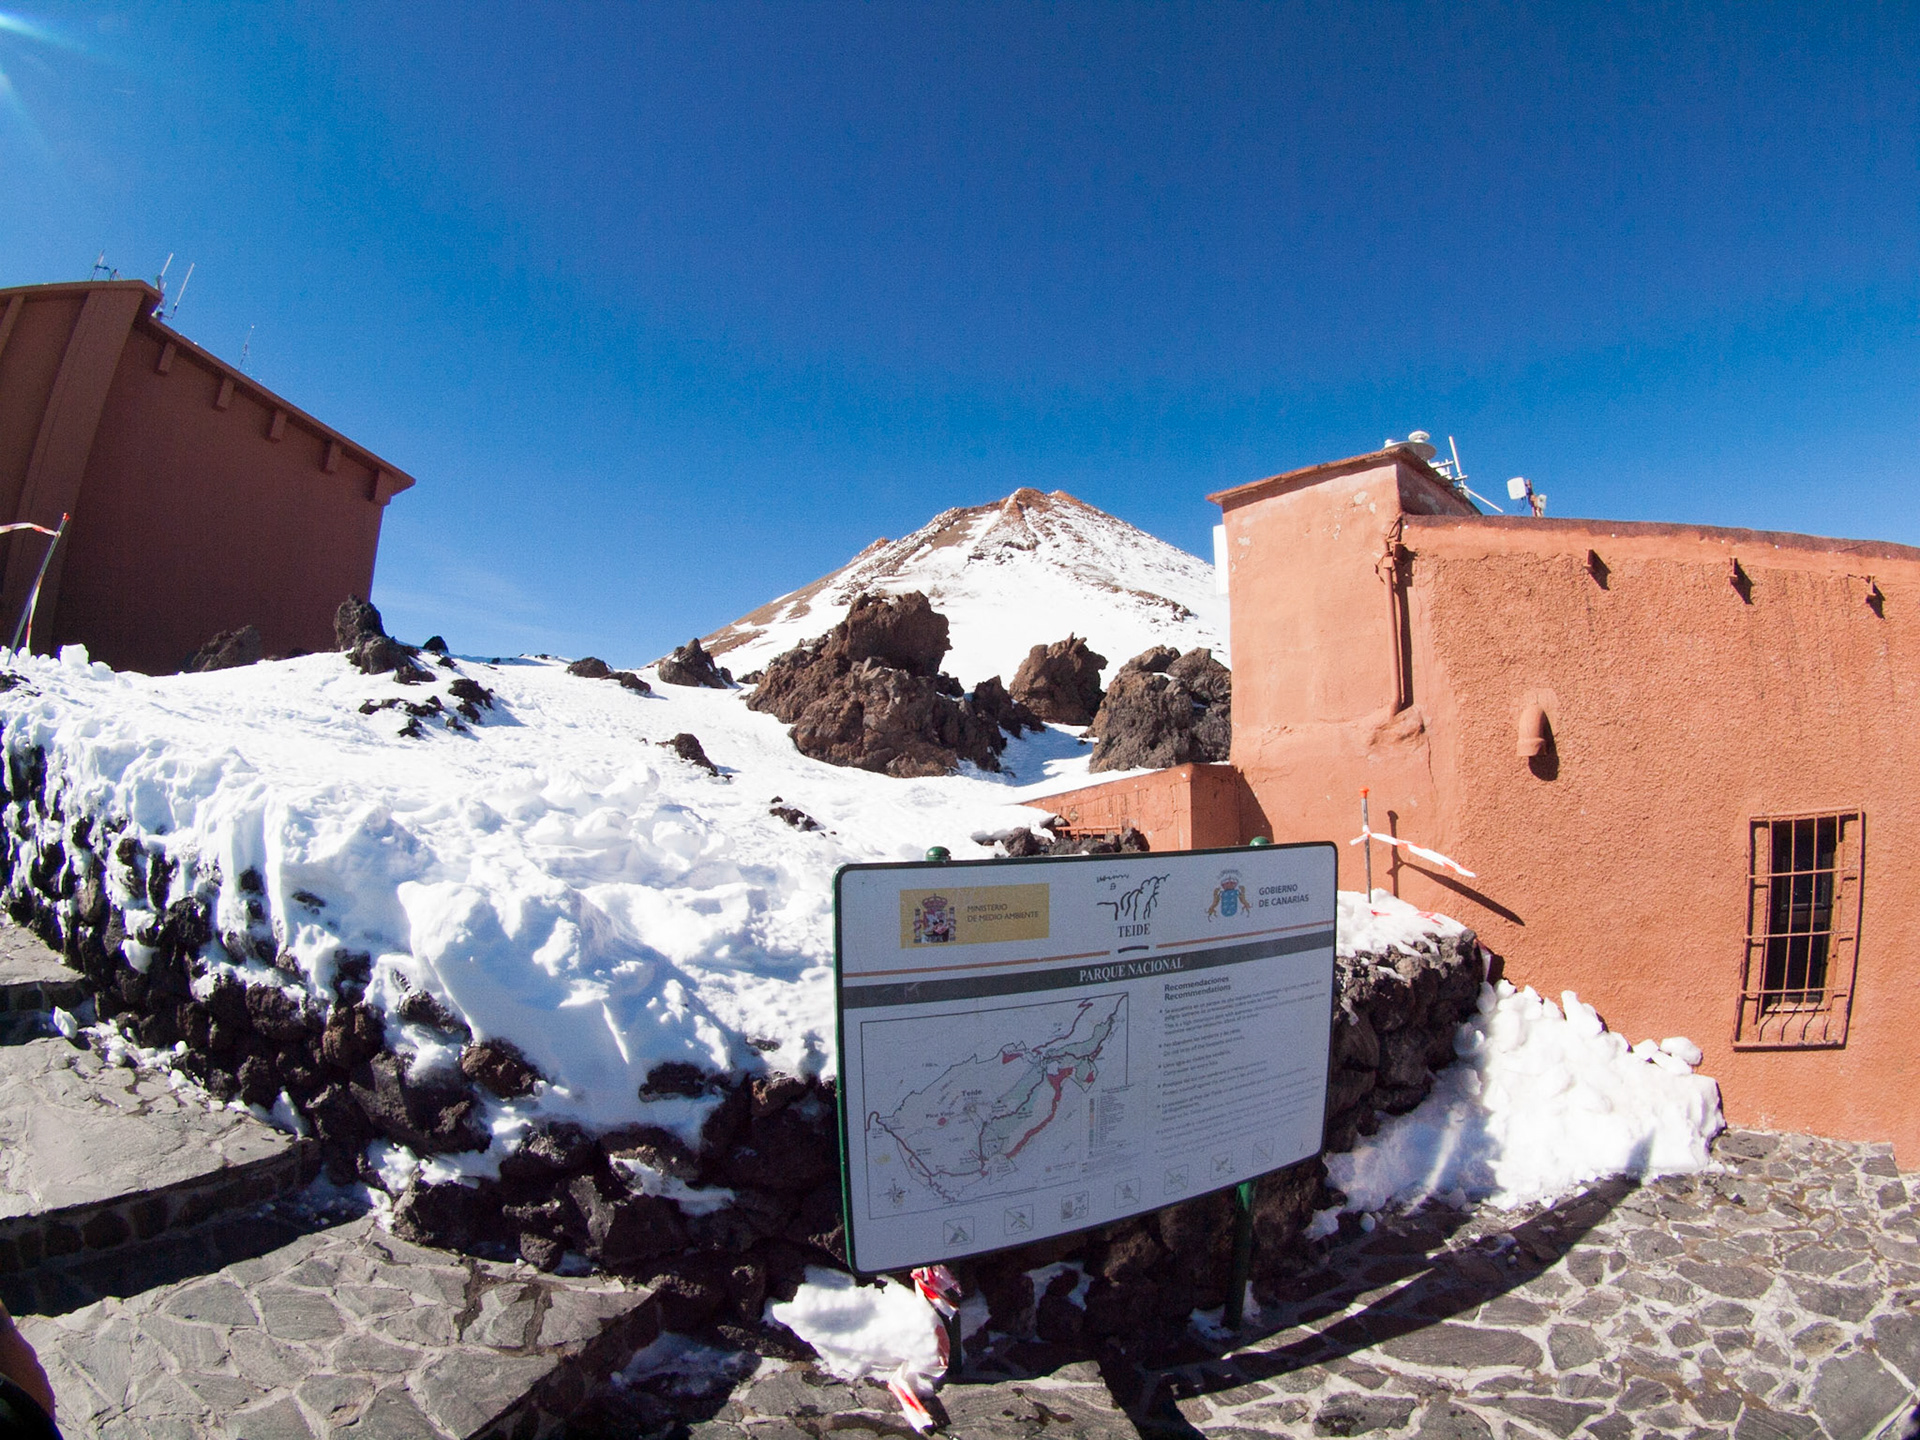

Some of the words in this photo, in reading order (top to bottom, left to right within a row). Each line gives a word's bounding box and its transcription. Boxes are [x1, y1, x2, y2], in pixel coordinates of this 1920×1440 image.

[1259, 884, 1298, 895] GOBIERNO
[966, 903, 1007, 913] MINISTERIO
[1258, 898, 1270, 909] DE
[1271, 892, 1310, 906] CANARIAS
[967, 914, 978, 923] DE
[978, 913, 1003, 923] MEDIO
[1004, 910, 1039, 920] AMBIENTE
[1117, 922, 1151, 938] TEIDE
[1078, 966, 1127, 983] PARQUE
[1129, 957, 1184, 976] NACIONAL
[1164, 975, 1230, 992] Recomendaciones
[1164, 984, 1231, 1001] Recommendations
